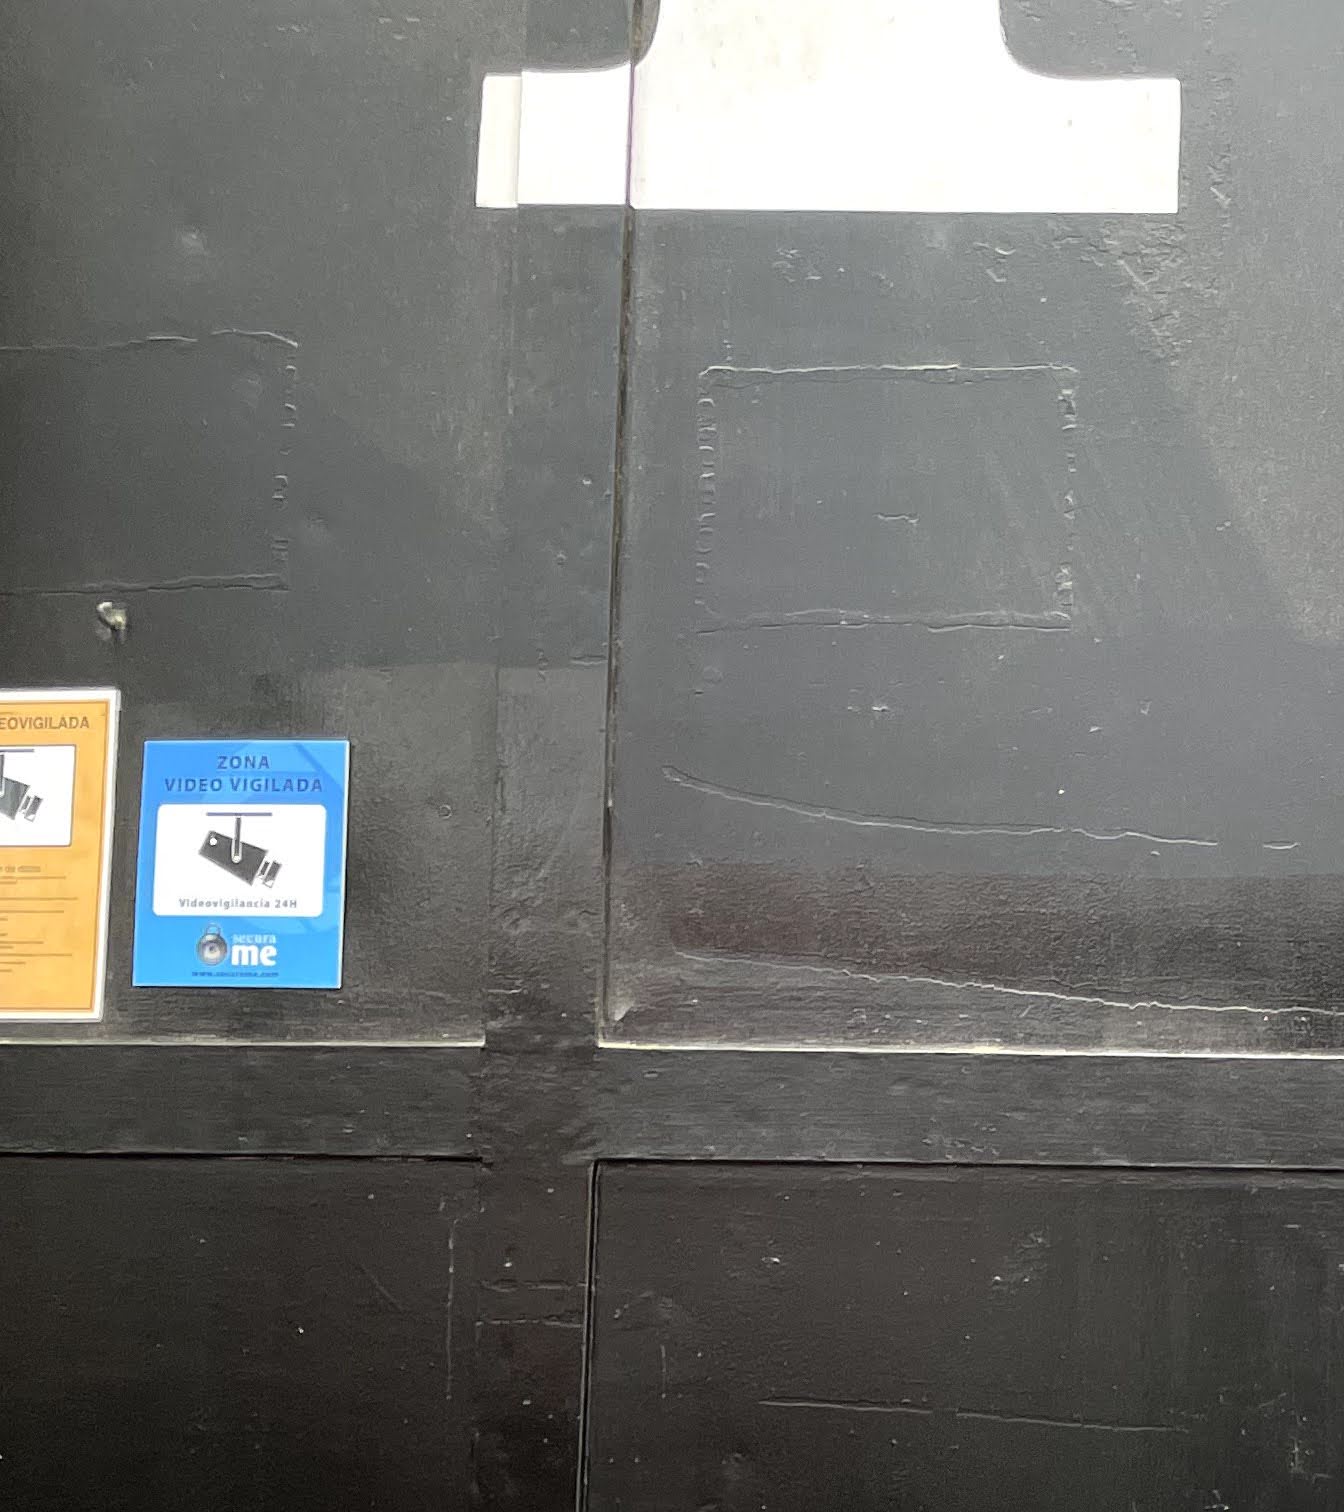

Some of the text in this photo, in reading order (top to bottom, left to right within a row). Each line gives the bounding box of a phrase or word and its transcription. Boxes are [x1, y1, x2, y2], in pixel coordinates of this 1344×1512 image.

[216, 755, 270, 770] ZONA
[164, 778, 323, 793] VIDEO VIGILADA
[178, 898, 298, 911] Videovigilancia 24H
[231, 944, 278, 967] me
